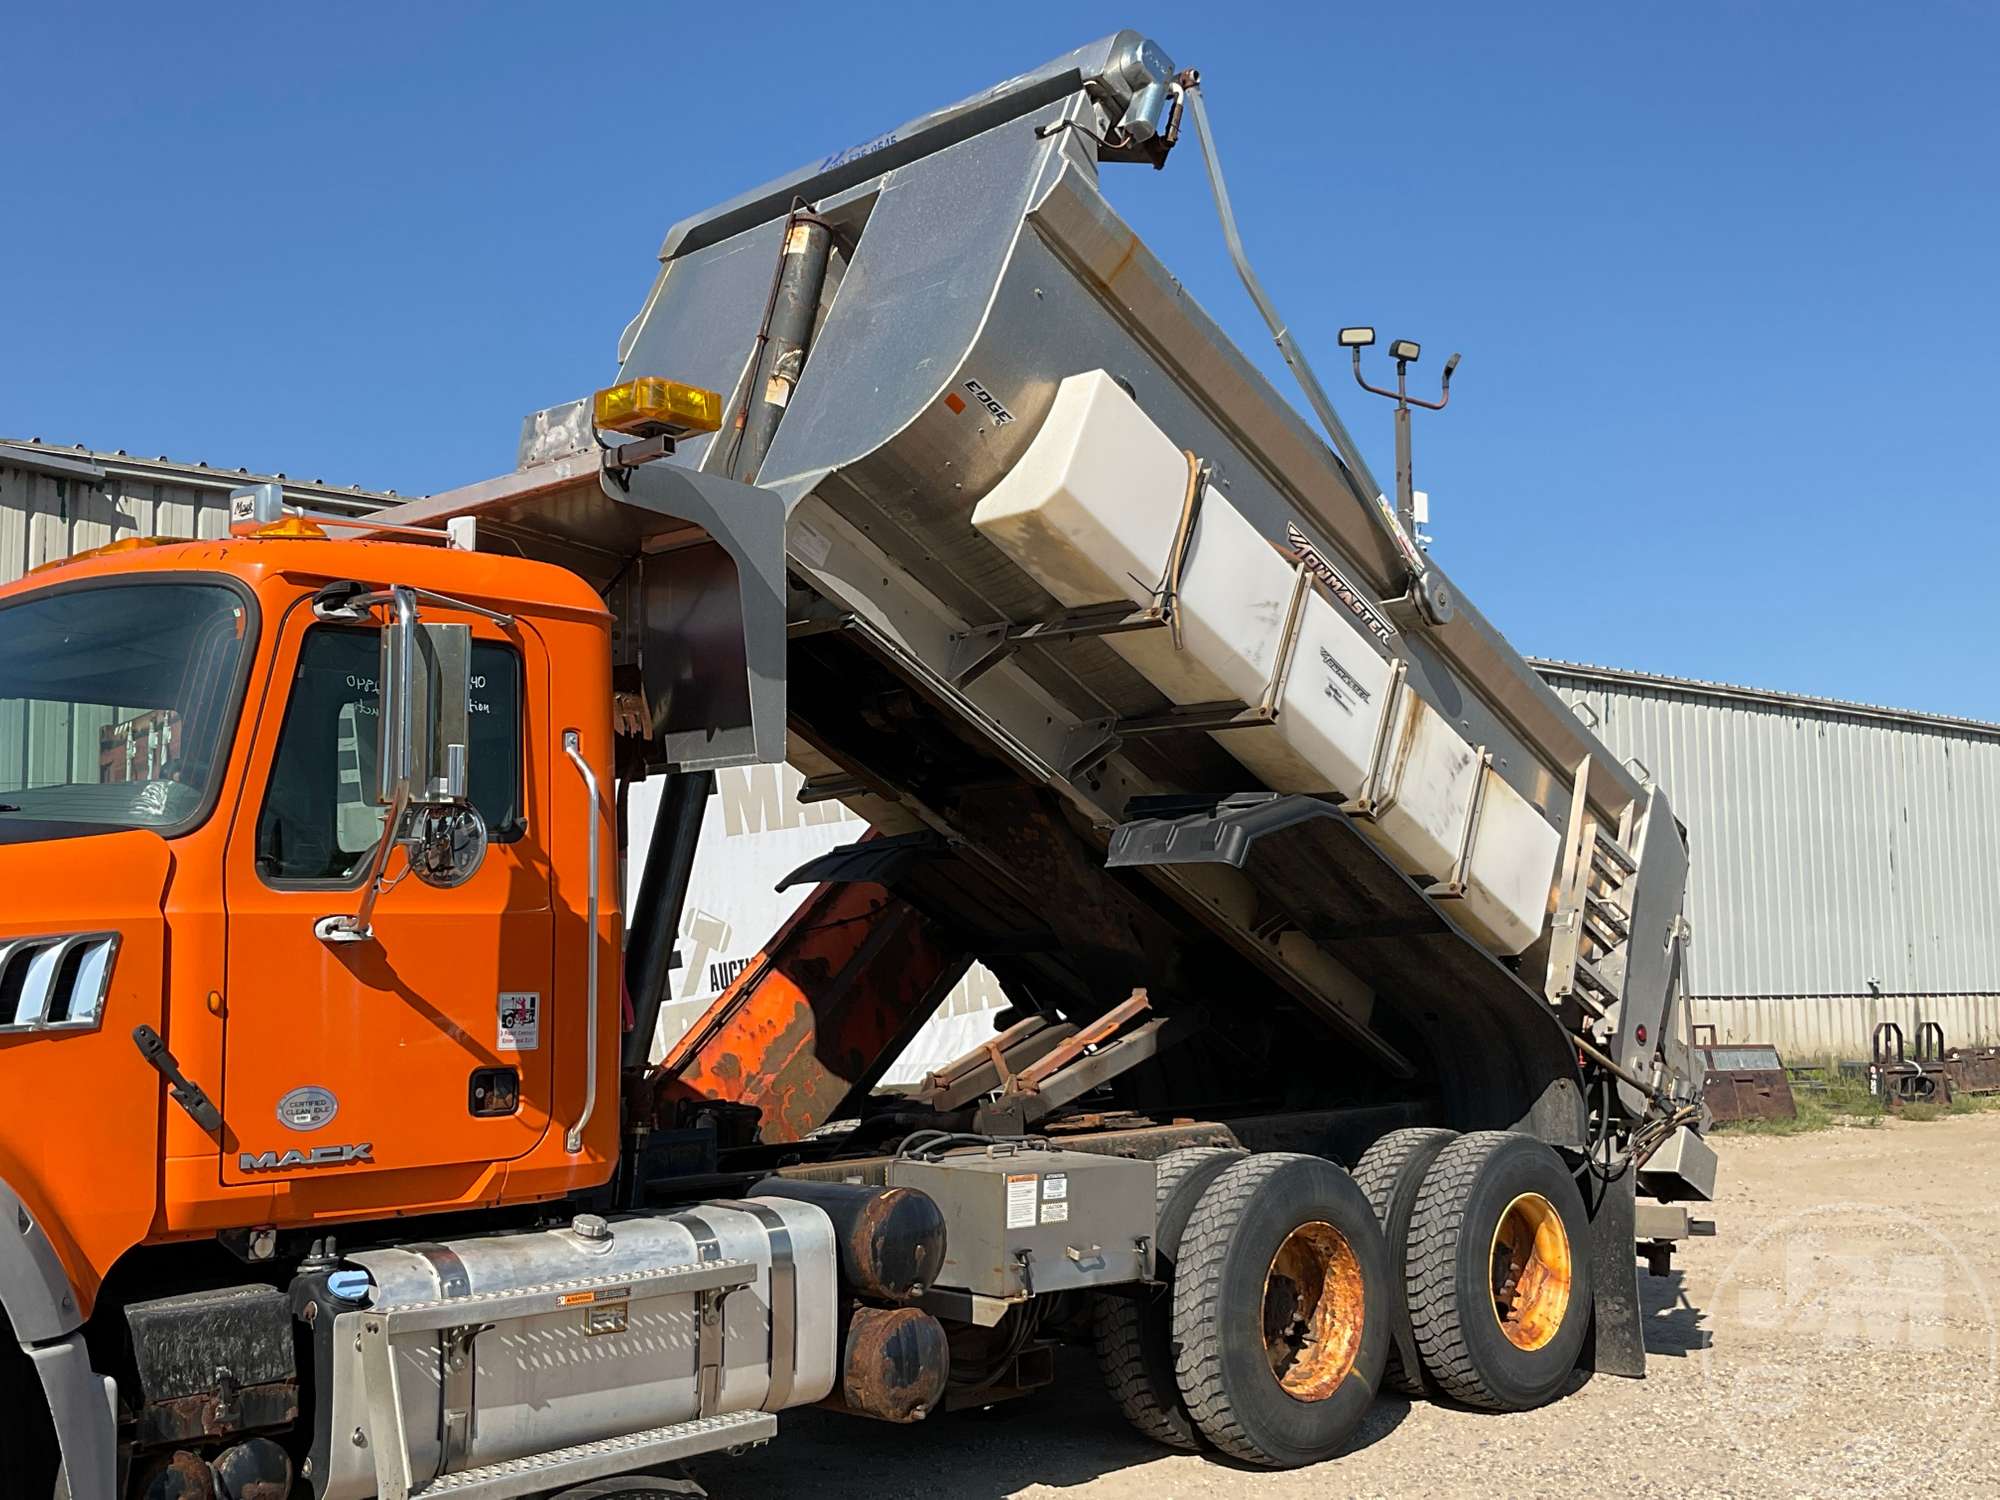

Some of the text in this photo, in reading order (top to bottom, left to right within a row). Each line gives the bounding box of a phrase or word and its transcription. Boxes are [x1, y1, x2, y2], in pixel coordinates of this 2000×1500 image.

[964, 380, 1014, 423] EDGE
[1287, 522, 1396, 646] TOWMASTER
[1319, 646, 1371, 705] TOWMASTER
[289, 1099, 327, 1108] CERTIFIED
[313, 1105, 330, 1113] IDLE
[240, 1143, 374, 1170] MACK
